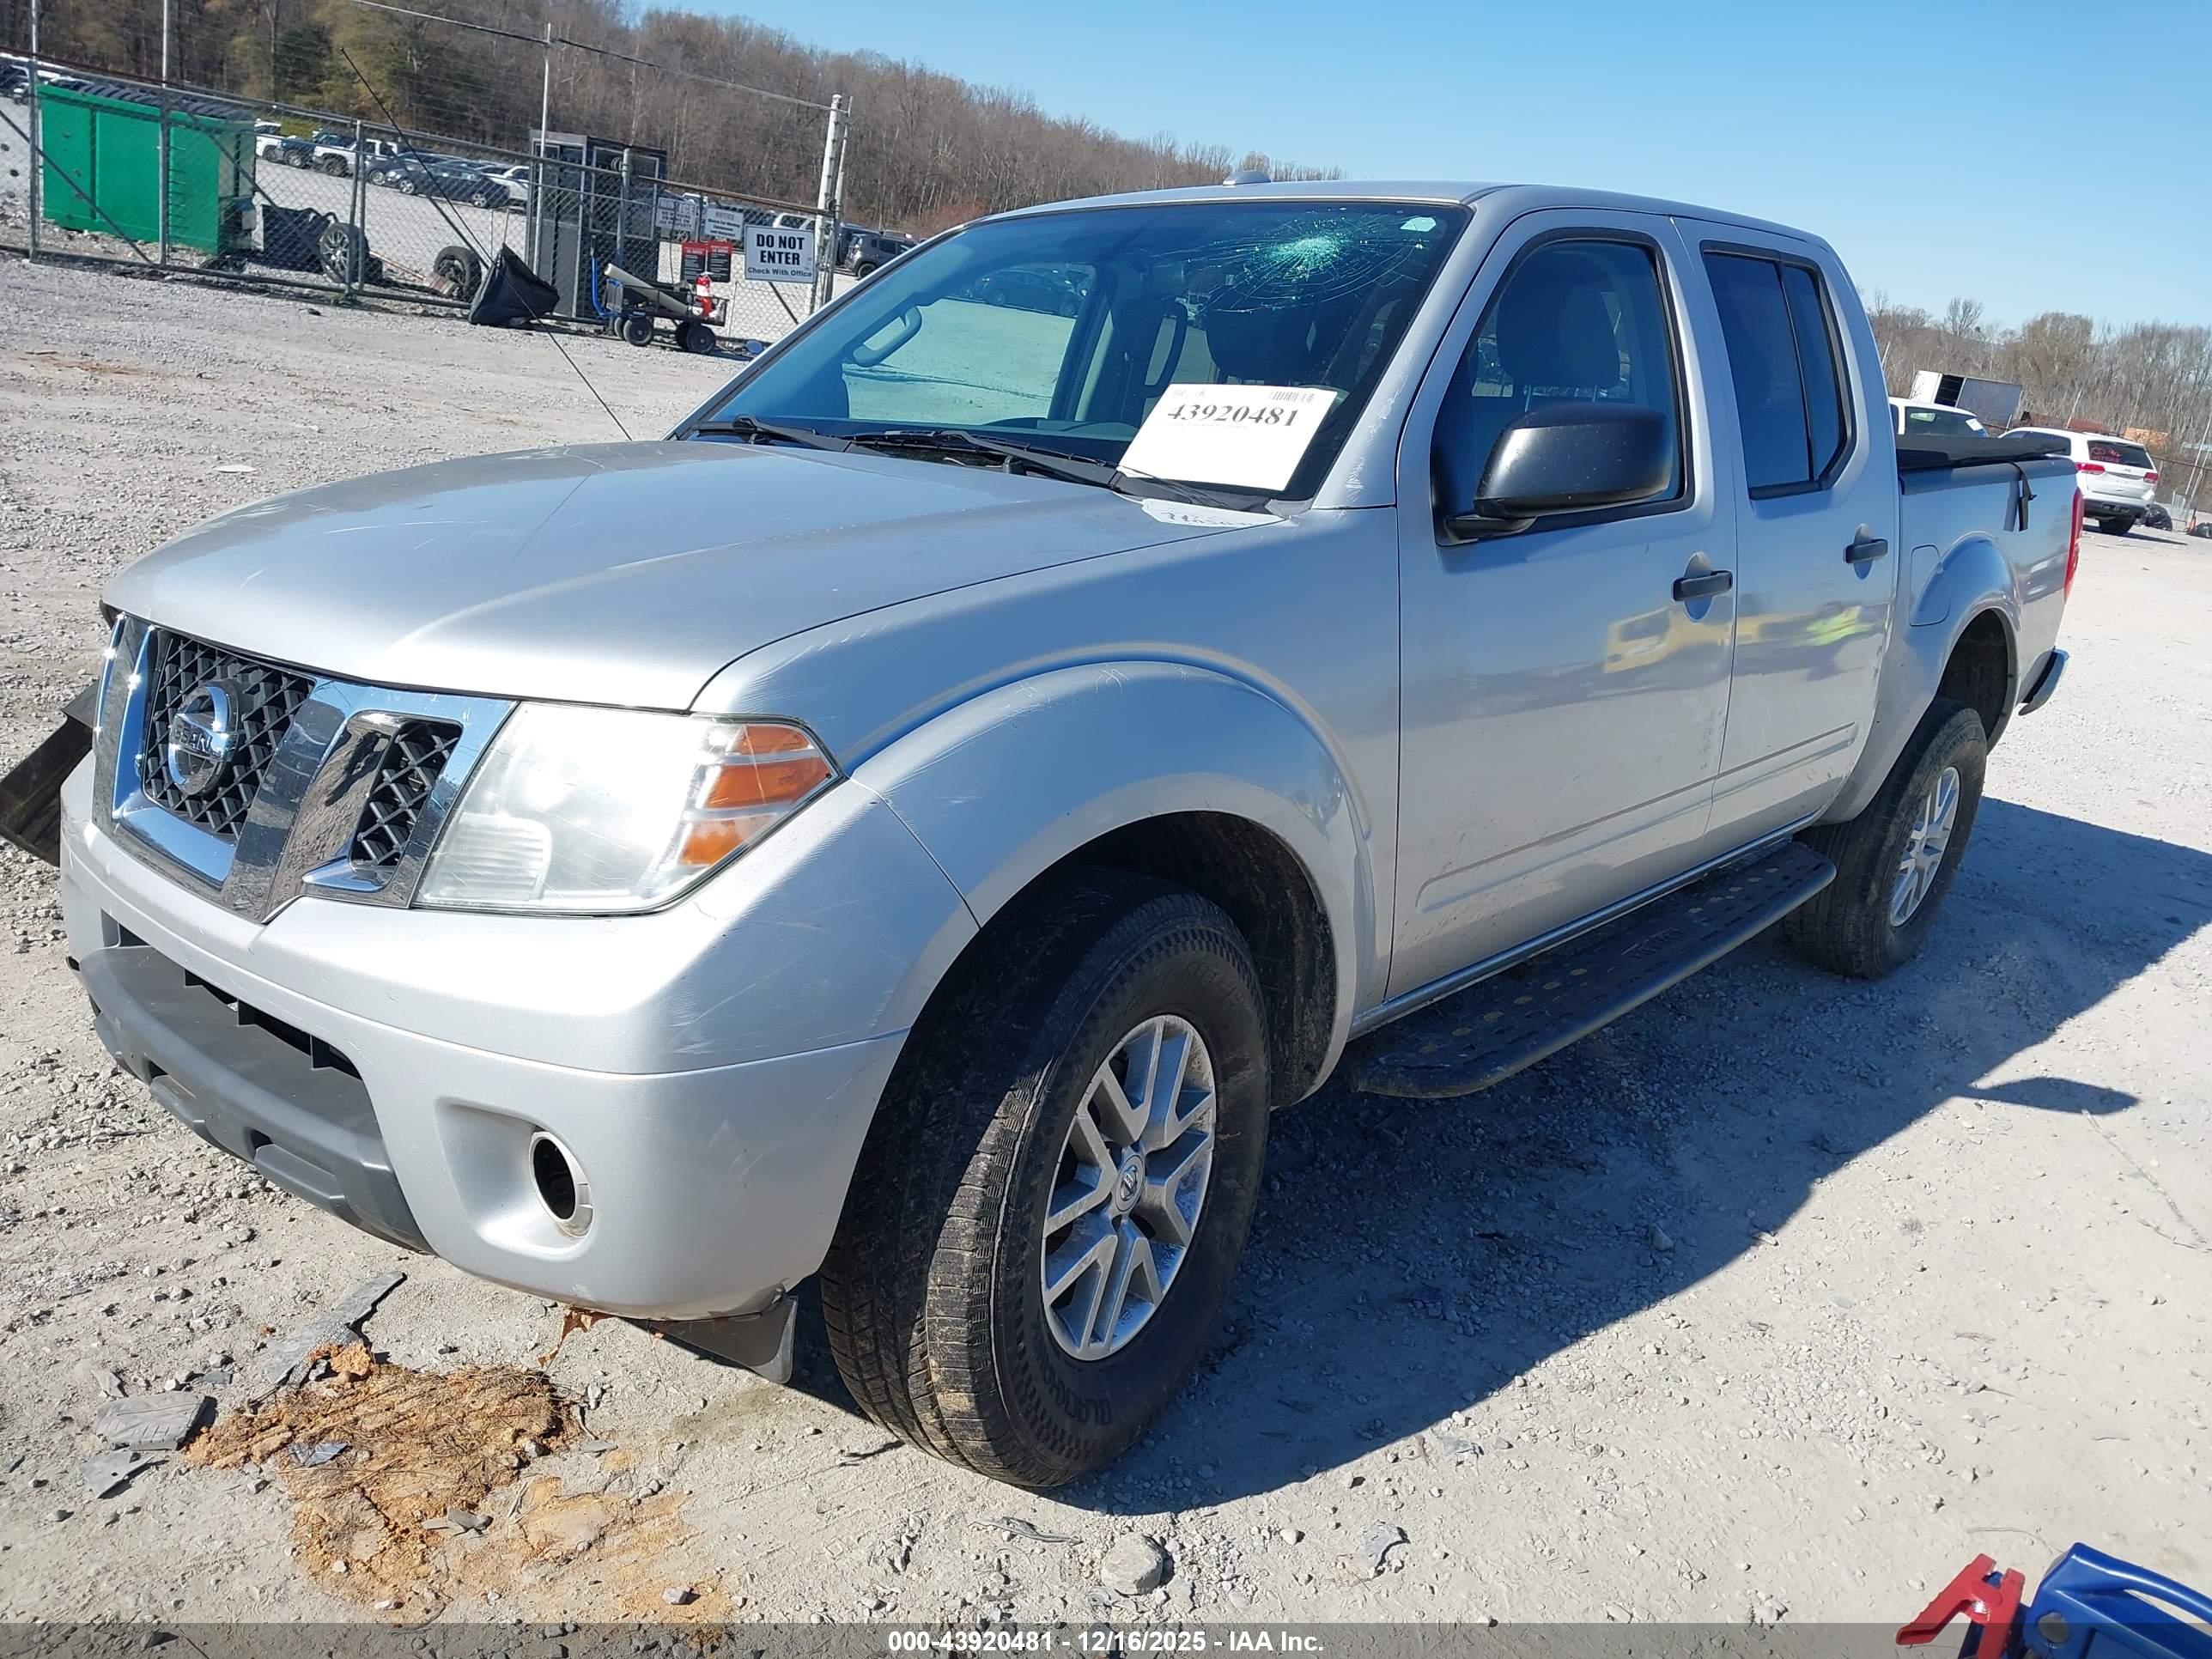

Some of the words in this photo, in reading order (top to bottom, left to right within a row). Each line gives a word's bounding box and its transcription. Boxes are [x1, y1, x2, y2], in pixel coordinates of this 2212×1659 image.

[659, 200, 695, 214] NOICE
[757, 234, 775, 248] DO
[779, 235, 805, 250] NOT
[760, 250, 800, 265] ENTER
[747, 266, 770, 275] Check
[1167, 403, 1299, 427] 43920481
